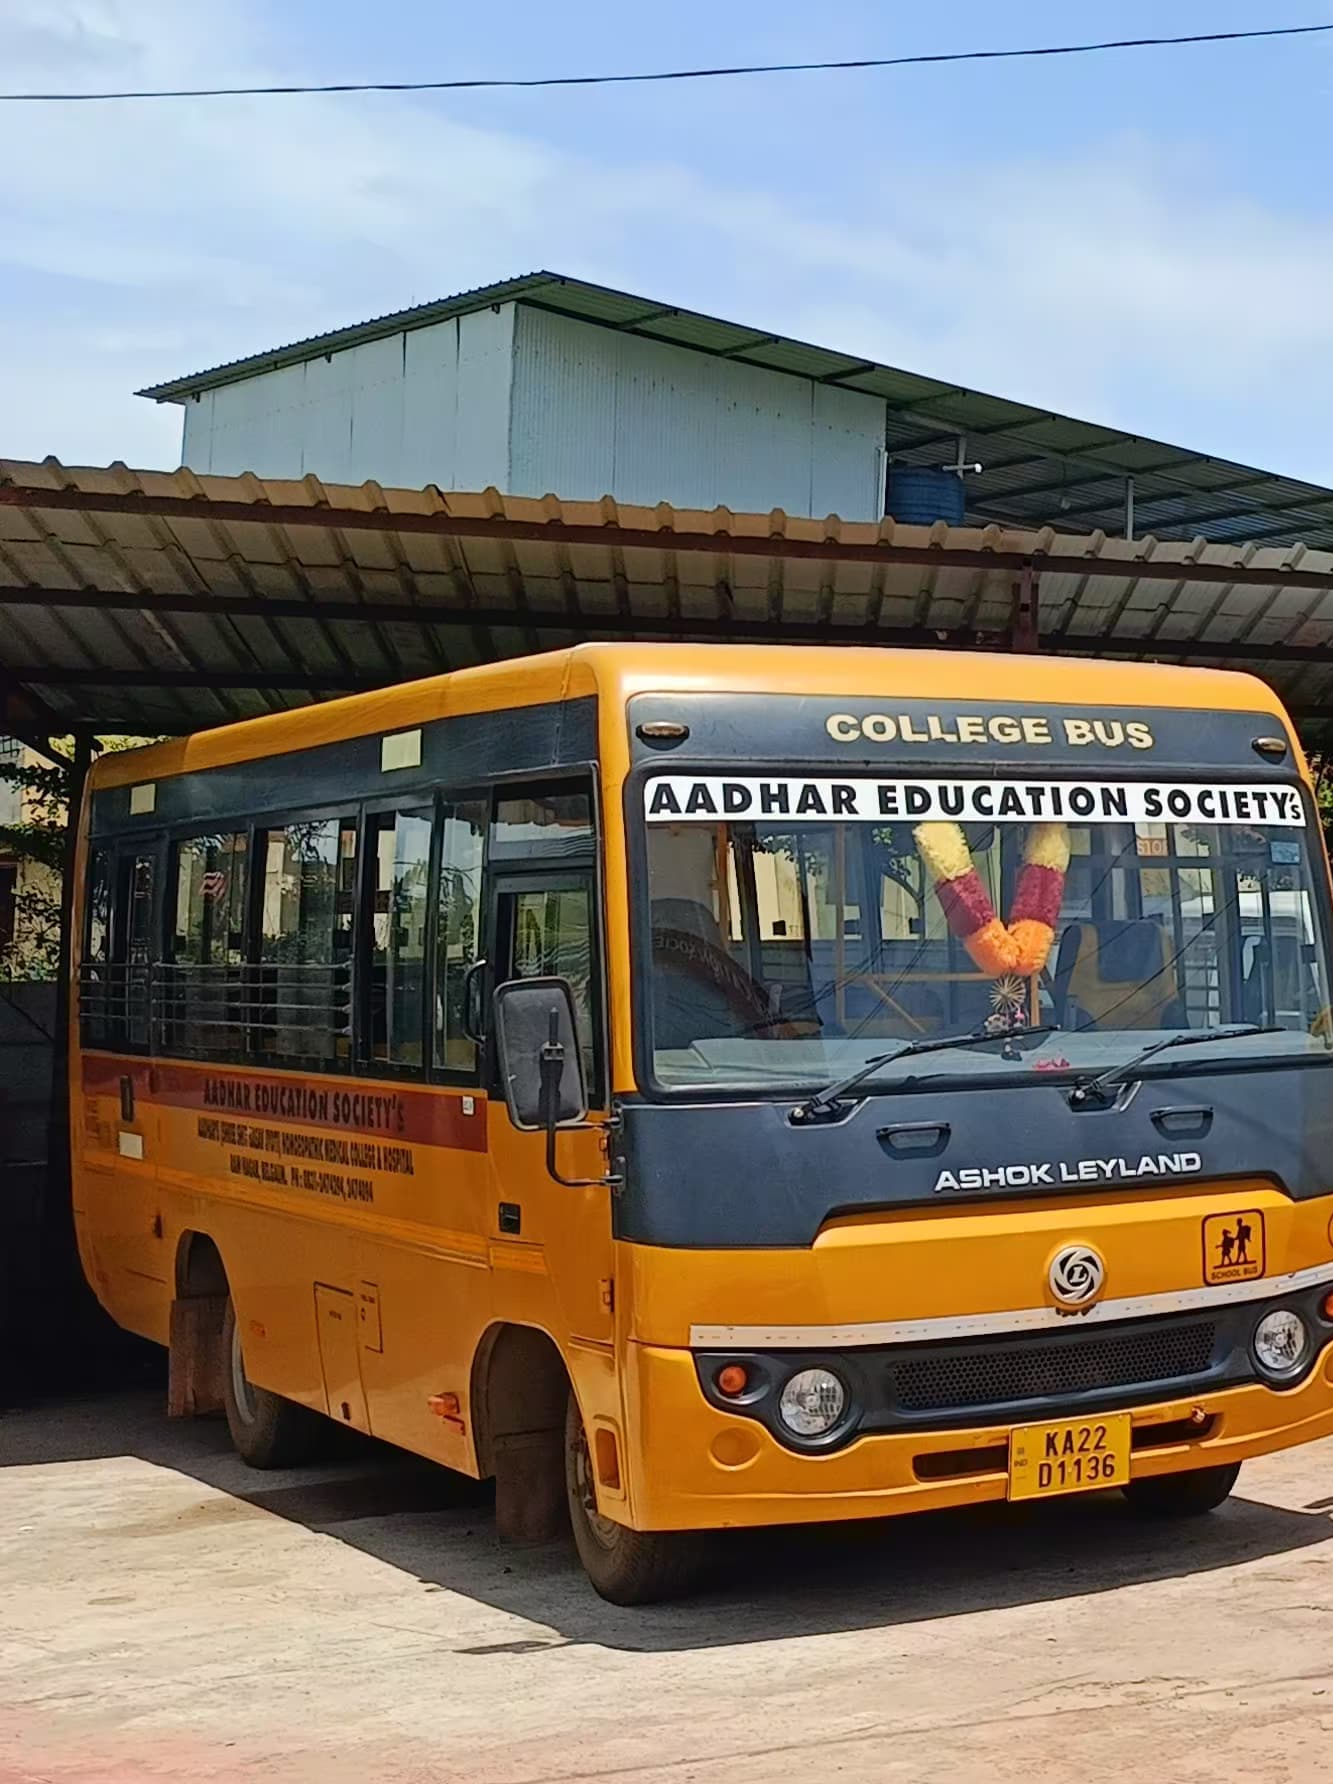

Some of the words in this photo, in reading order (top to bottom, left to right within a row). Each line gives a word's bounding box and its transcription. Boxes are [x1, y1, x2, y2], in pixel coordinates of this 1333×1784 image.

[825, 713, 1052, 745] COLLEGE
[1063, 717, 1155, 749] BUS
[649, 783, 859, 815] AADHAR
[877, 784, 1128, 817] EDUCATION
[204, 1079, 250, 1111] AADHAR
[255, 1084, 328, 1120] EDUCATION
[934, 1162, 1055, 1192] ASHOK
[1059, 1152, 1202, 1183] LEYLAND
[1211, 1268, 1241, 1281] SCHOOL
[1044, 1425, 1108, 1458] KA22
[1038, 1453, 1116, 1490] D1136
